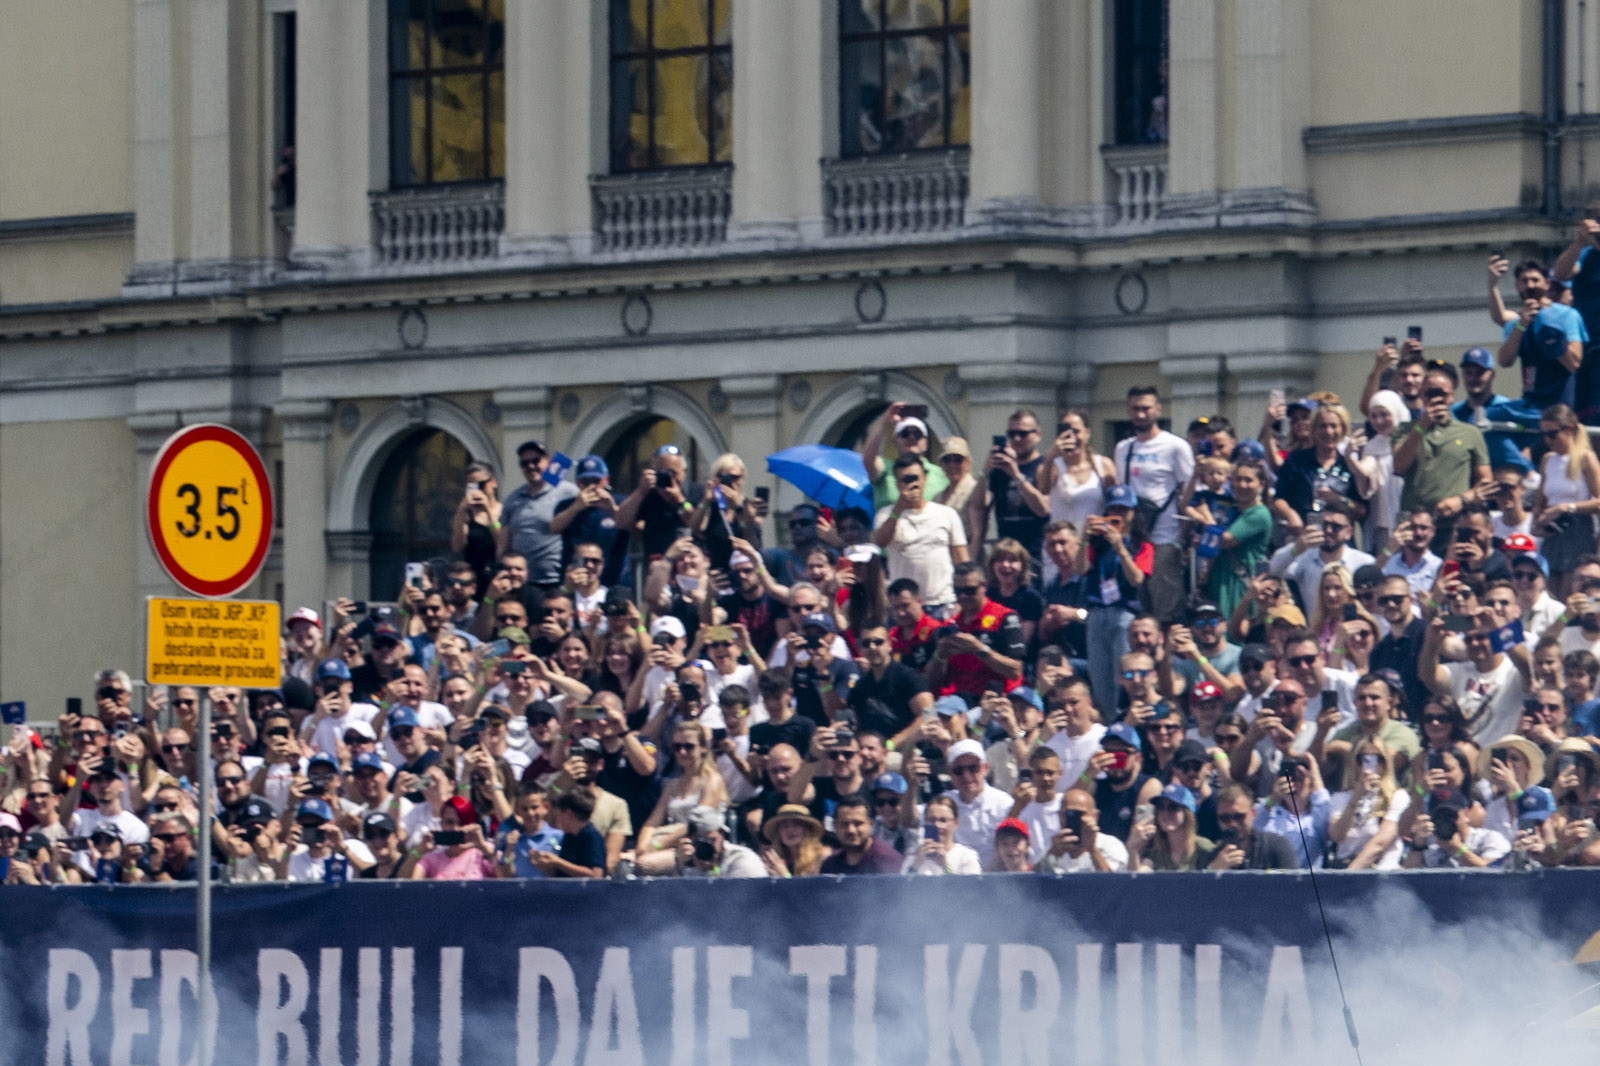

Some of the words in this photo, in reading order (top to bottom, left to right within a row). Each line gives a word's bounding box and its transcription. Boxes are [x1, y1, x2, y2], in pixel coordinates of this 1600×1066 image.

[161, 602, 187, 618] Osim
[190, 602, 220, 619] vozila
[197, 625, 258, 644] intervencija
[152, 661, 222, 680] prehrambene
[225, 662, 275, 681] proizvode
